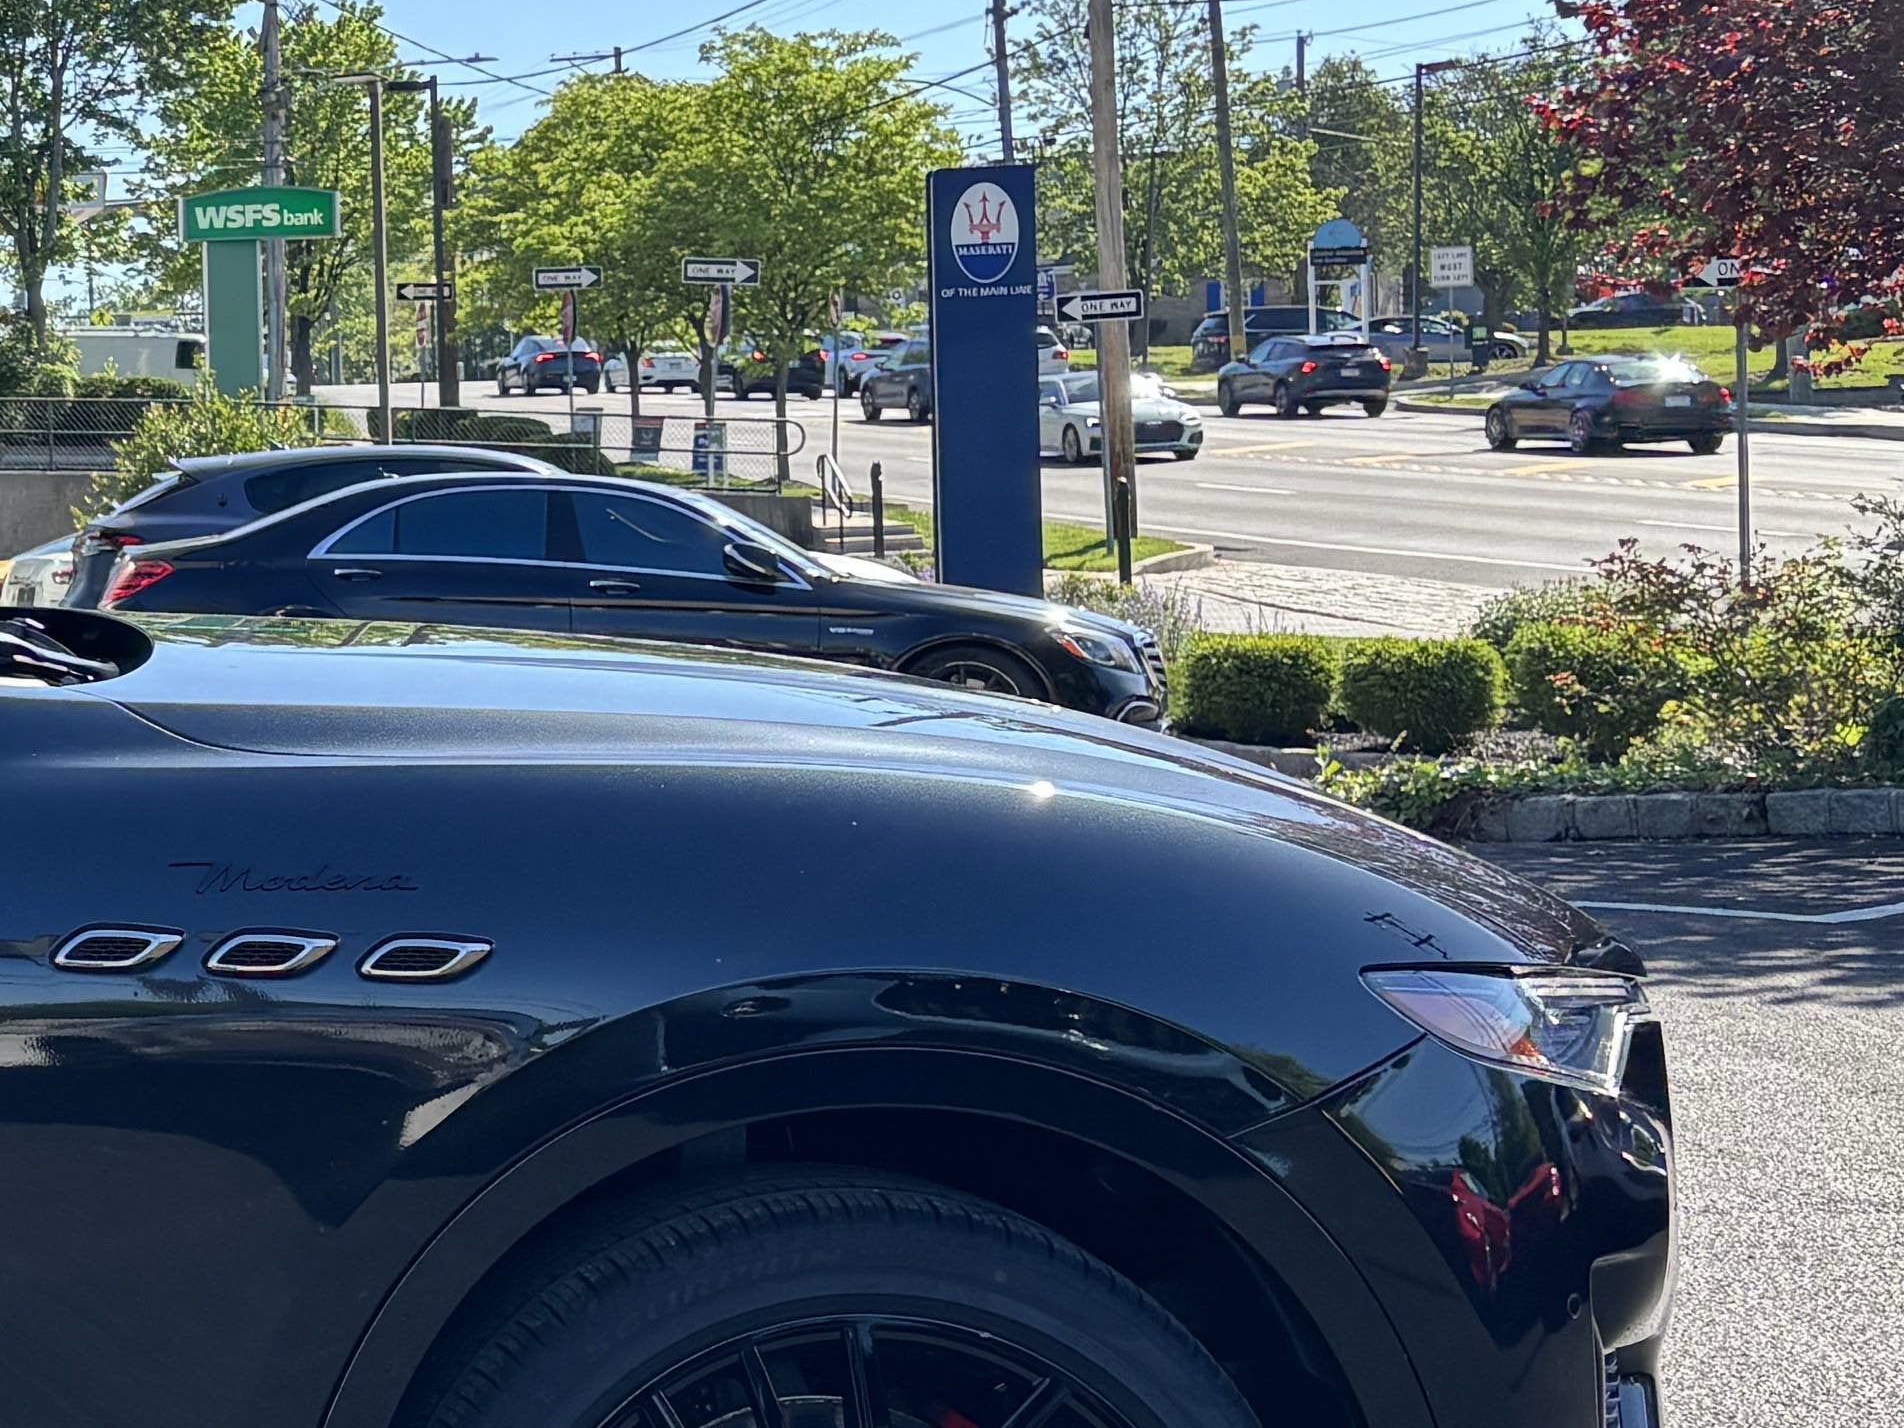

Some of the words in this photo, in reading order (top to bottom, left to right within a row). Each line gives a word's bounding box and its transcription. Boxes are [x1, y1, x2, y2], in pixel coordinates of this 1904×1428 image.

[194, 203, 281, 230] WSFS
[283, 208, 324, 226] bank
[958, 245, 1013, 256] MASERATI
[692, 266, 710, 274] ONE
[941, 287, 956, 298] OF
[957, 287, 978, 297] THE
[979, 286, 1008, 297] MAIN
[1081, 302, 1105, 313] ONE
[1110, 300, 1132, 310] WAY
[167, 862, 419, 895] Modena
